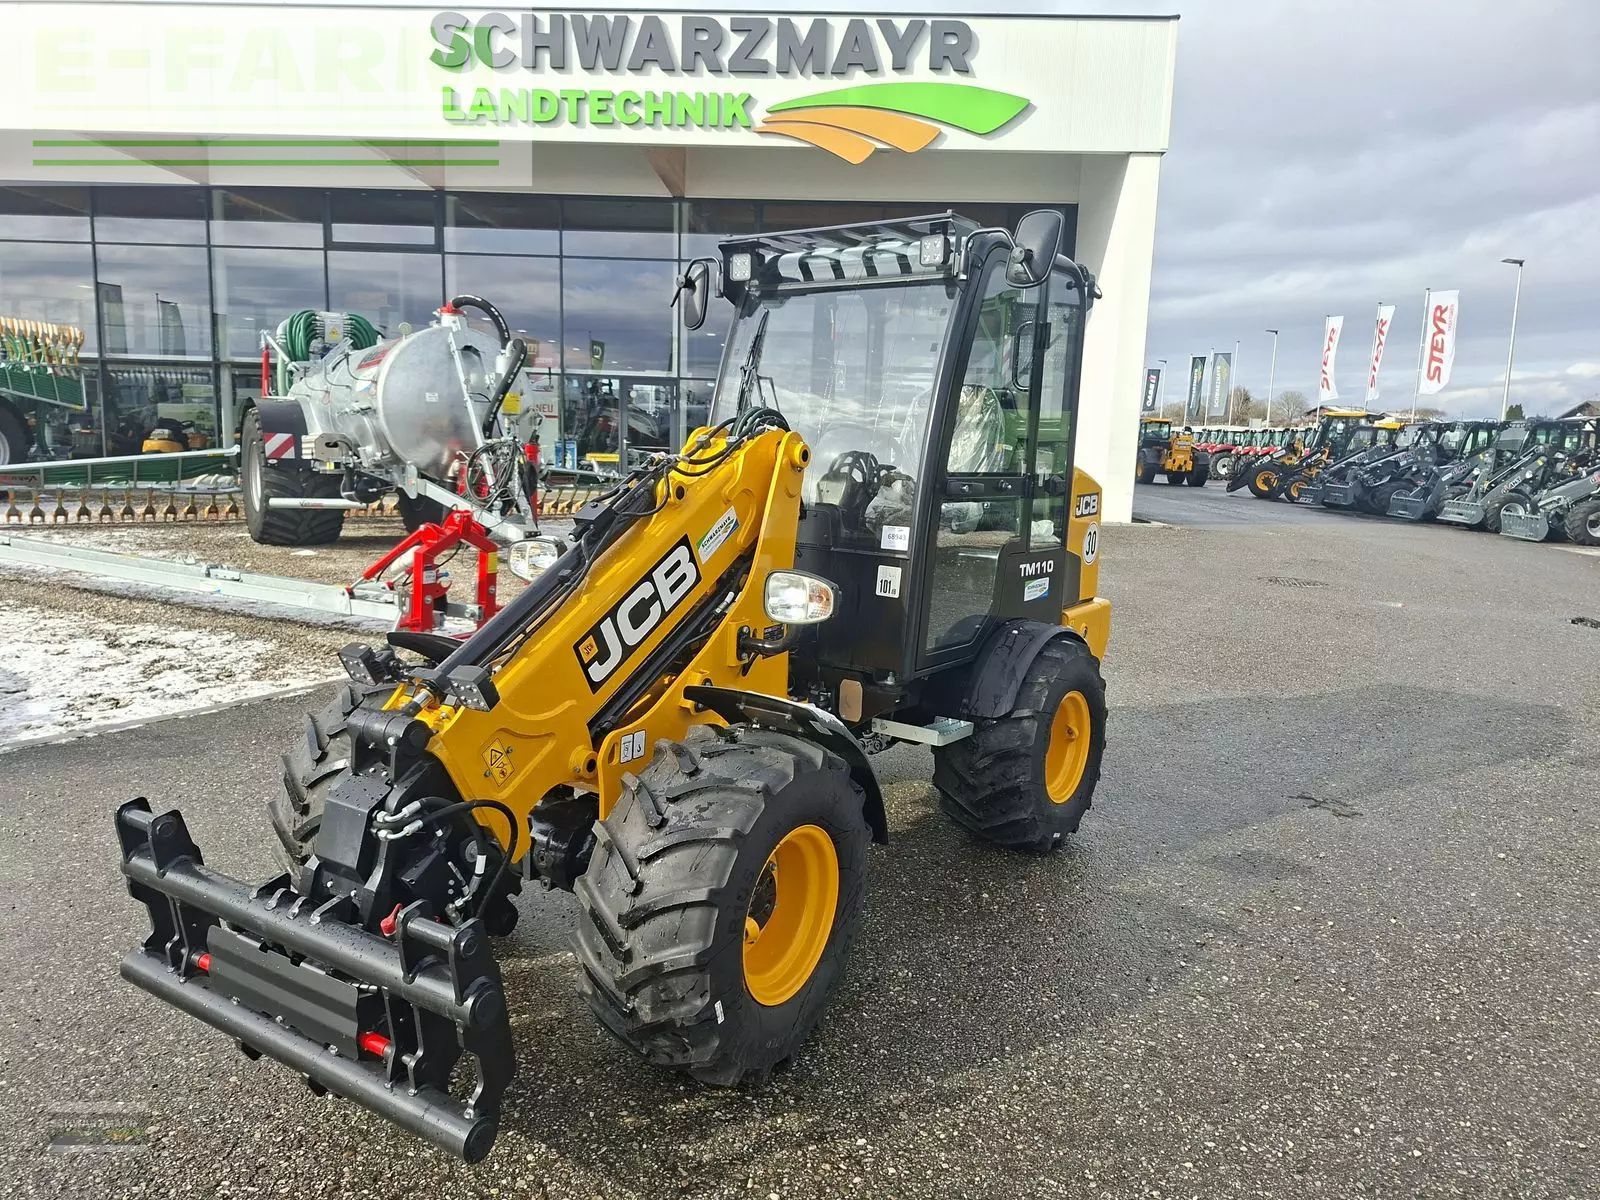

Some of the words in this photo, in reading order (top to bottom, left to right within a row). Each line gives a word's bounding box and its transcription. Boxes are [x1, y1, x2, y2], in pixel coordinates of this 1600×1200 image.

[429, 10, 975, 75] SCHWARZMAYR
[442, 87, 753, 129] LANDTECHNIK
[1427, 304, 1449, 384] STEYR
[536, 403, 554, 413] NEU
[1076, 495, 1098, 516] JCB
[1085, 531, 1097, 556] 30
[1019, 560, 1054, 577] TM110
[880, 578, 892, 594] 101
[587, 545, 697, 683] JCB
